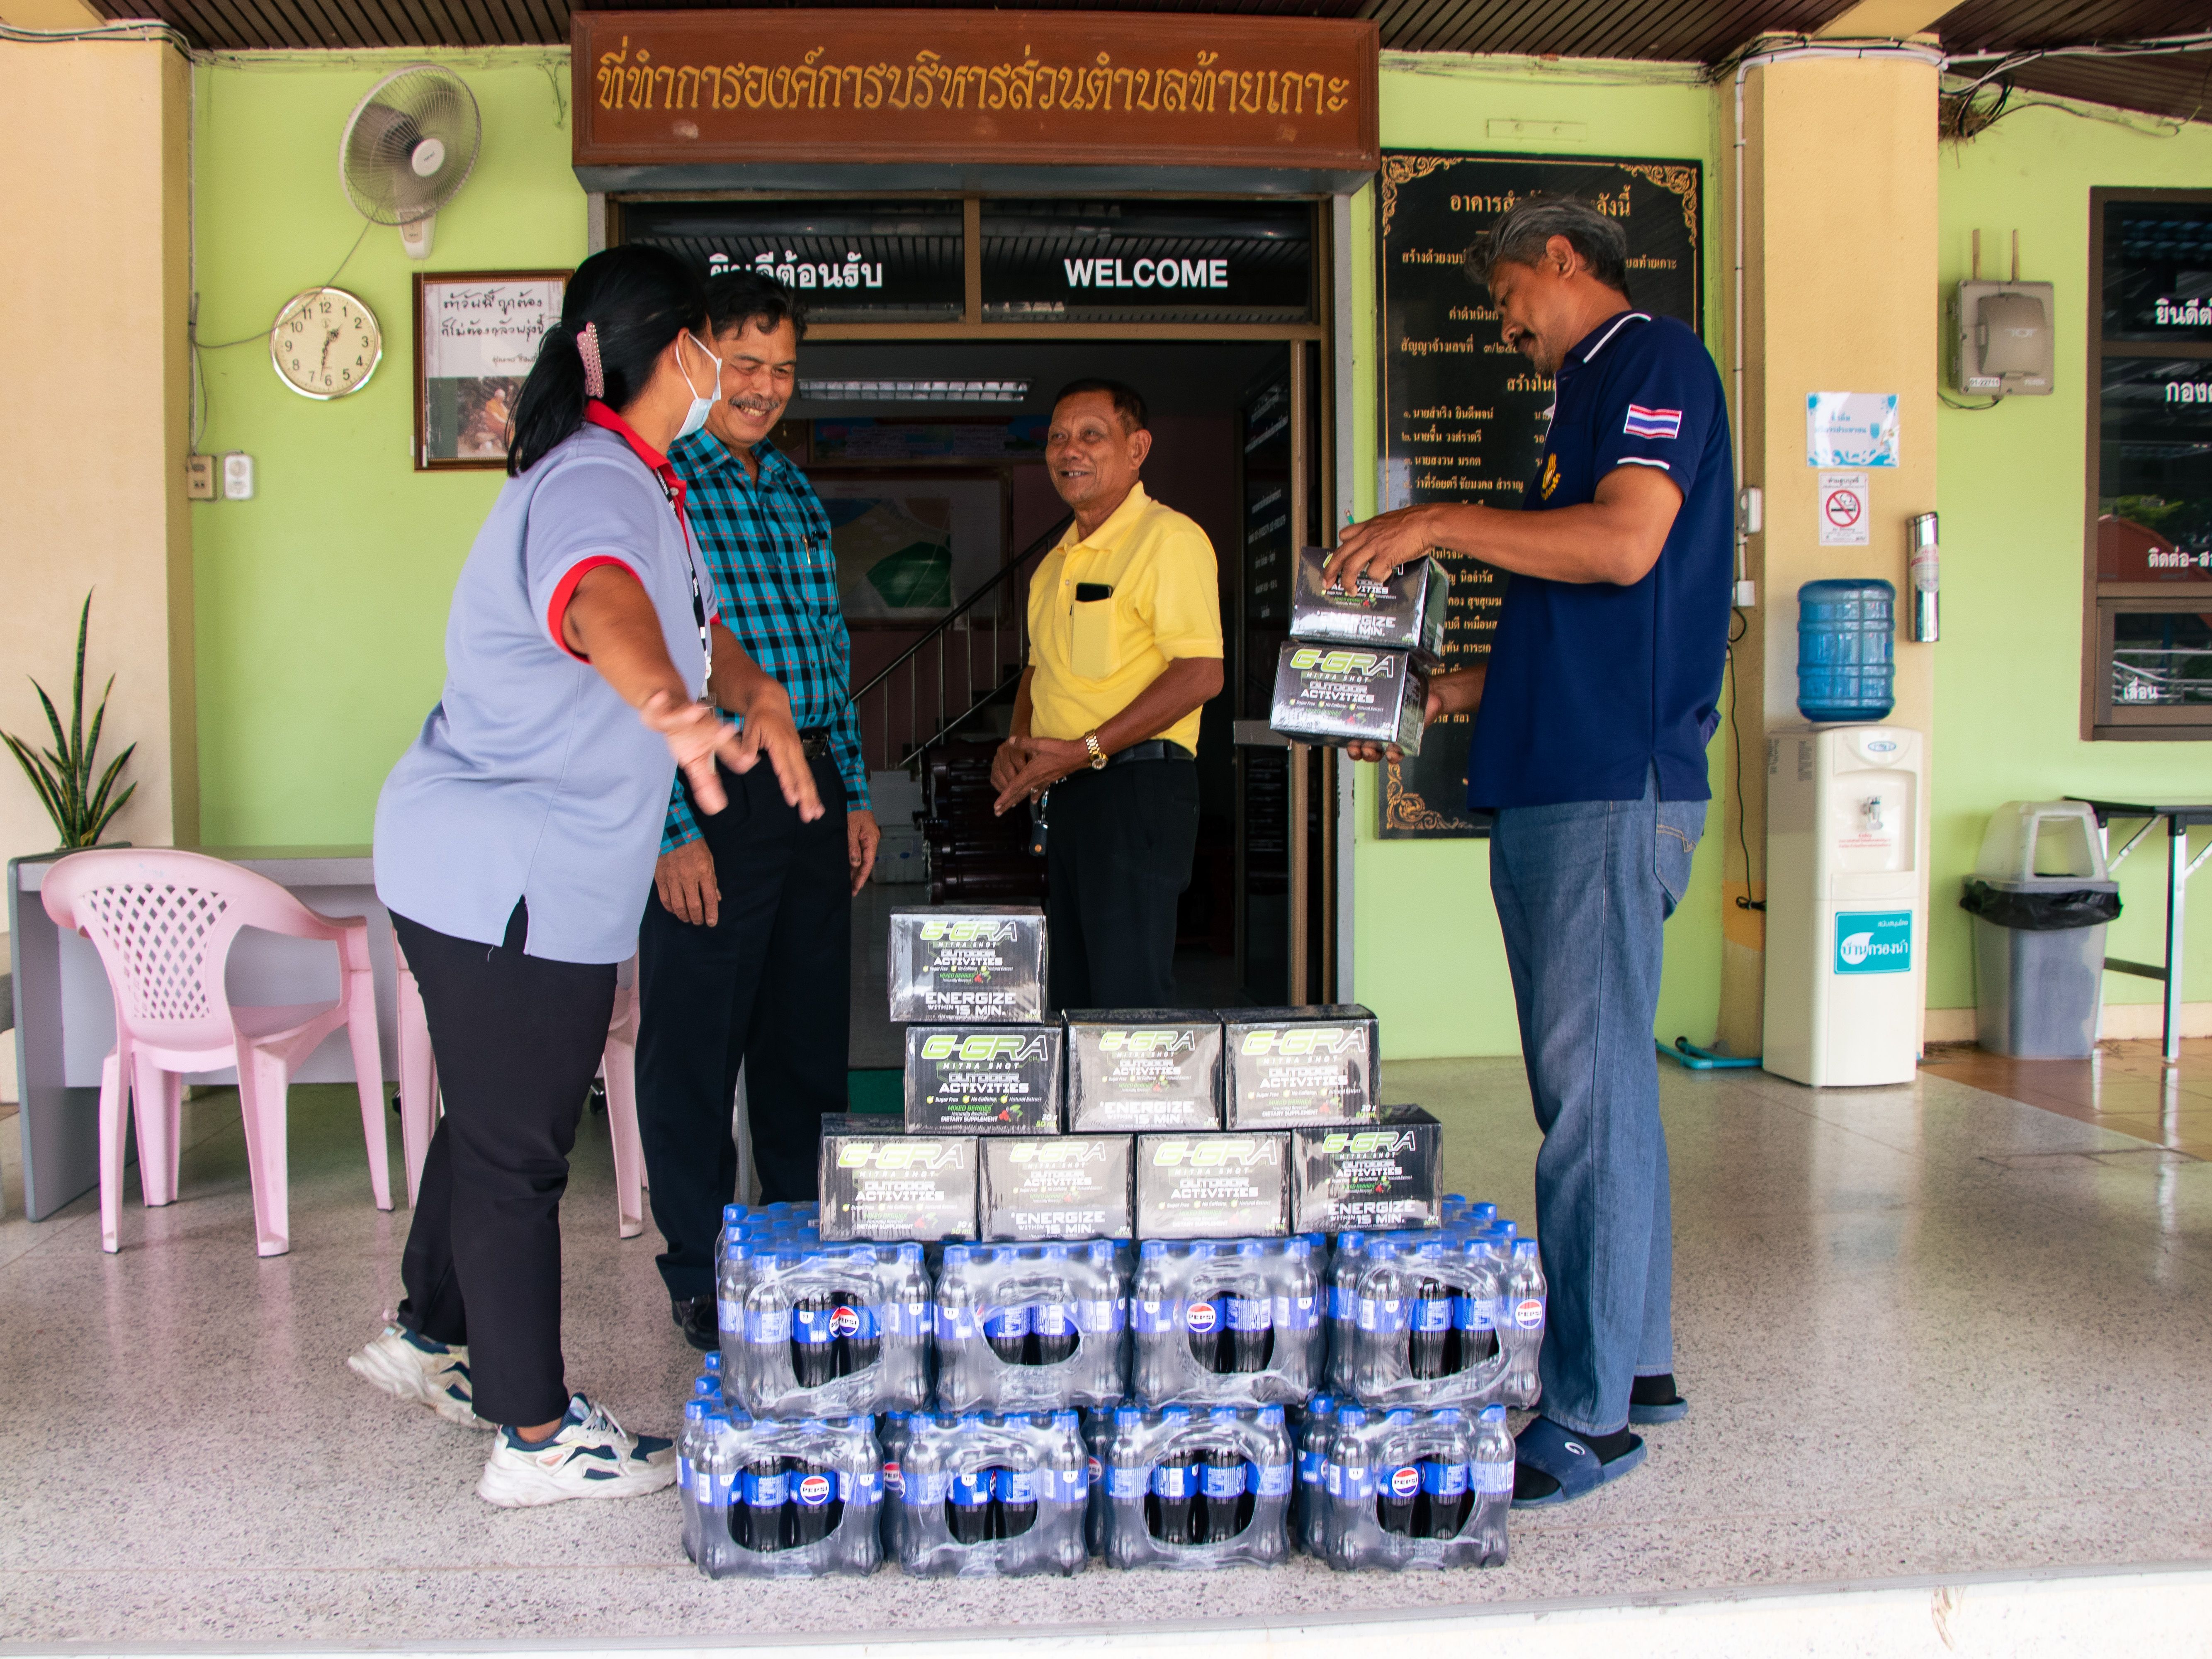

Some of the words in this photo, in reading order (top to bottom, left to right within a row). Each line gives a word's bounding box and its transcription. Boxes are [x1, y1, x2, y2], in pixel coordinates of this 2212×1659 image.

[596, 36, 1350, 115] ที่ทำการองค์การบริหารส่วนตำบลท้ายเกาะ
[1065, 259, 1228, 288] WELCOME
[302, 307, 311, 319] 11
[319, 302, 331, 313] 12
[343, 306, 347, 317] 1
[291, 321, 303, 333] 10
[355, 317, 362, 328] 2
[285, 340, 292, 352] 9
[361, 336, 369, 348] 3
[292, 358, 300, 370] 8
[356, 355, 363, 366] 4
[309, 370, 316, 382] 7
[343, 369, 350, 380] 5
[324, 375, 332, 386] 6
[1290, 648, 1393, 678] G-GRA
[1306, 672, 1336, 681] MITRA
[1343, 674, 1369, 683] SHOT
[1310, 681, 1368, 695] OUTDOOR
[1300, 689, 1374, 704] ACTIVITIES
[920, 921, 1017, 942] G-GRA
[1843, 939, 1908, 955] บ้านกรองน้ำ
[941, 949, 996, 958] OUTDOOR
[934, 957, 1003, 966] ACTIVITIES
[955, 1005, 970, 1015] 15
[975, 1005, 1005, 1015] MIN.
[1099, 1030, 1195, 1051] G-GRA
[1241, 1027, 1366, 1056] G-GRA
[921, 1035, 1048, 1061] G-GRA
[1120, 1058, 1174, 1067] OUTDOOR
[1113, 1066, 1181, 1075] ACTIVITIES
[1269, 1065, 1339, 1078] OUTDOOR
[948, 1072, 1020, 1083] OUTDOOR
[1260, 1075, 1348, 1088] ACTIVITIES
[939, 1083, 1029, 1093] ACTIVITIES
[1134, 1114, 1149, 1124] 15
[1154, 1114, 1184, 1124] MIN.
[1322, 1131, 1416, 1153] G-GRA
[838, 1143, 964, 1169] G-GRA
[1009, 1141, 1106, 1163] G-GRA
[1153, 1139, 1277, 1167] G-GRA
[1342, 1159, 1395, 1169] OUTDOOR
[1031, 1170, 1085, 1178] OUTDOOR
[1336, 1167, 1403, 1177] ACTIVITIES
[865, 1181, 936, 1191] OUTDOOR
[1023, 1177, 1092, 1187] ACTIVITIES
[1180, 1177, 1249, 1188] OUTDOOR
[855, 1191, 944, 1201] ACTIVITIES
[1171, 1187, 1258, 1199] ACTIVITIES
[1356, 1214, 1371, 1224] 15
[1376, 1213, 1405, 1224] MIN.
[1045, 1224, 1061, 1234] 15
[1065, 1224, 1095, 1233] MIN.
